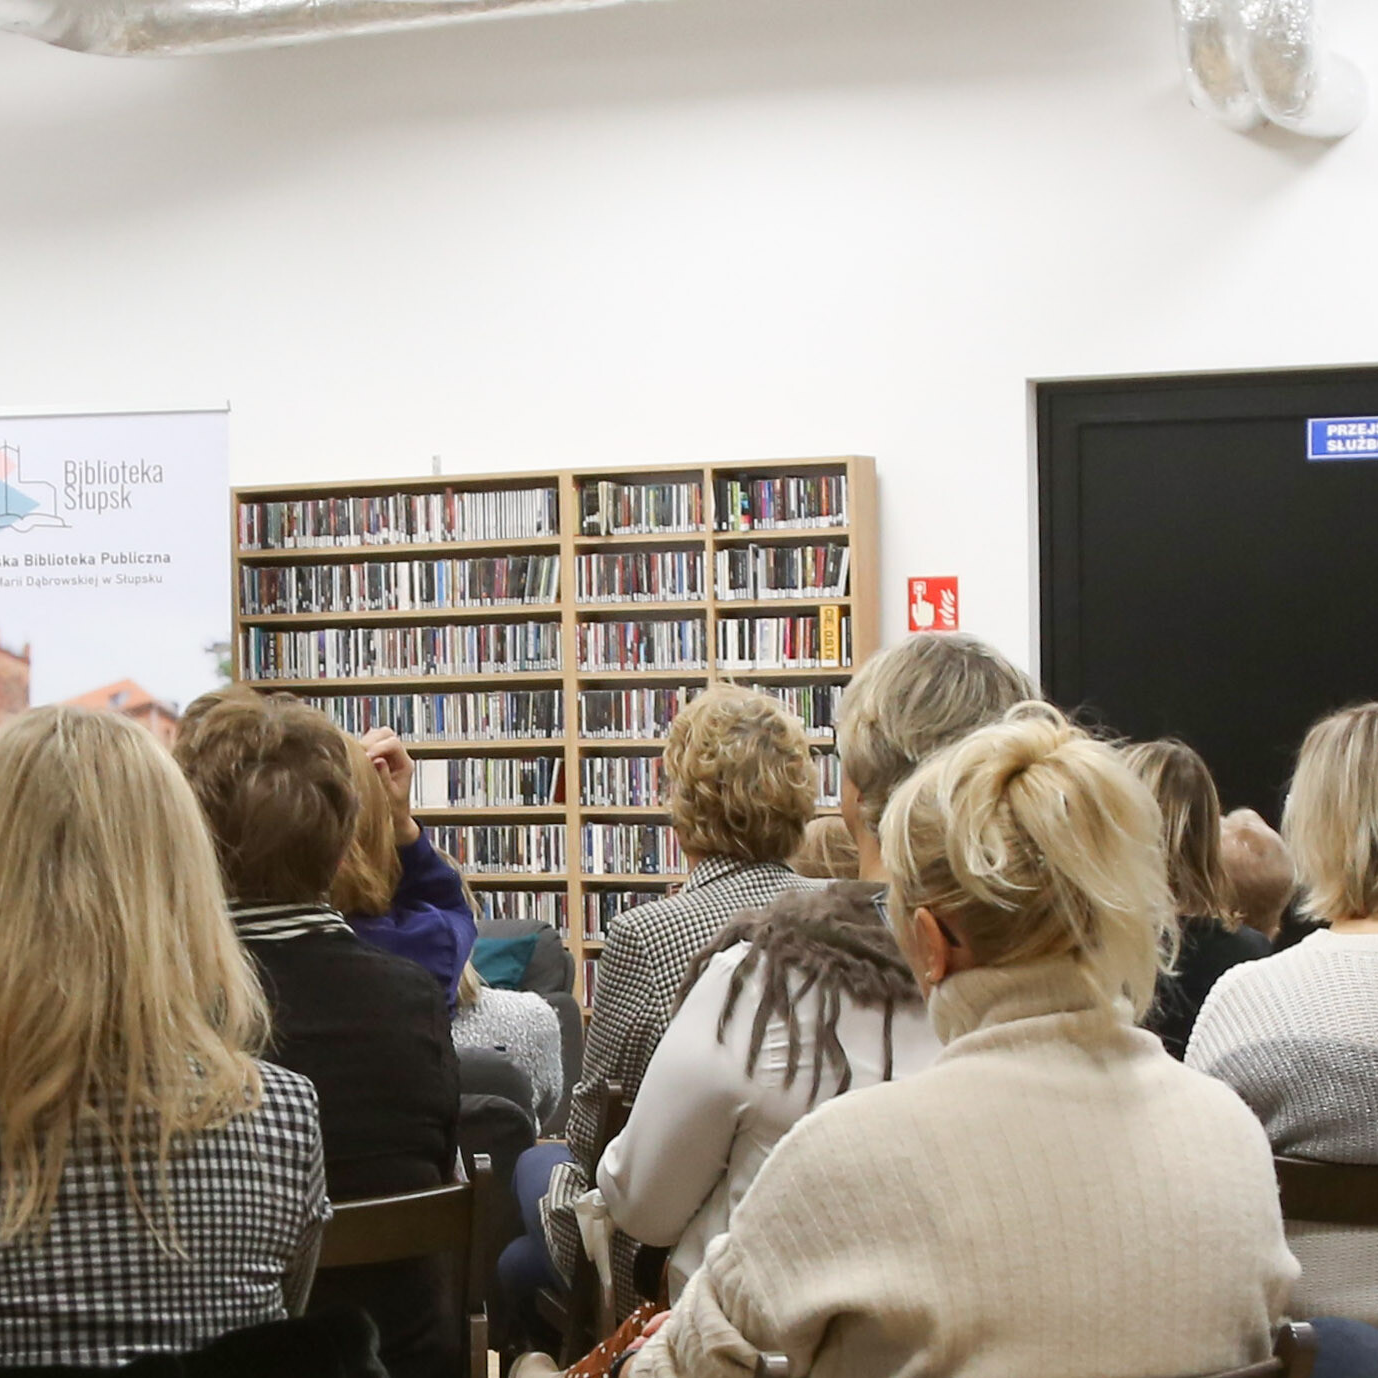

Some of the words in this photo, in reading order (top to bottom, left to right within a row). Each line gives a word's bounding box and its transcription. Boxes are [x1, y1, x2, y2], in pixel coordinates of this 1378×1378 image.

[64, 459, 164, 485] Biblioteka
[64, 484, 133, 514] Słupsk
[24, 553, 96, 567] Biblioteka
[101, 551, 171, 565] Publiczna
[26, 573, 98, 588] Dąbrowskiej
[102, 575, 112, 585] w
[115, 572, 163, 587] Słupsku
